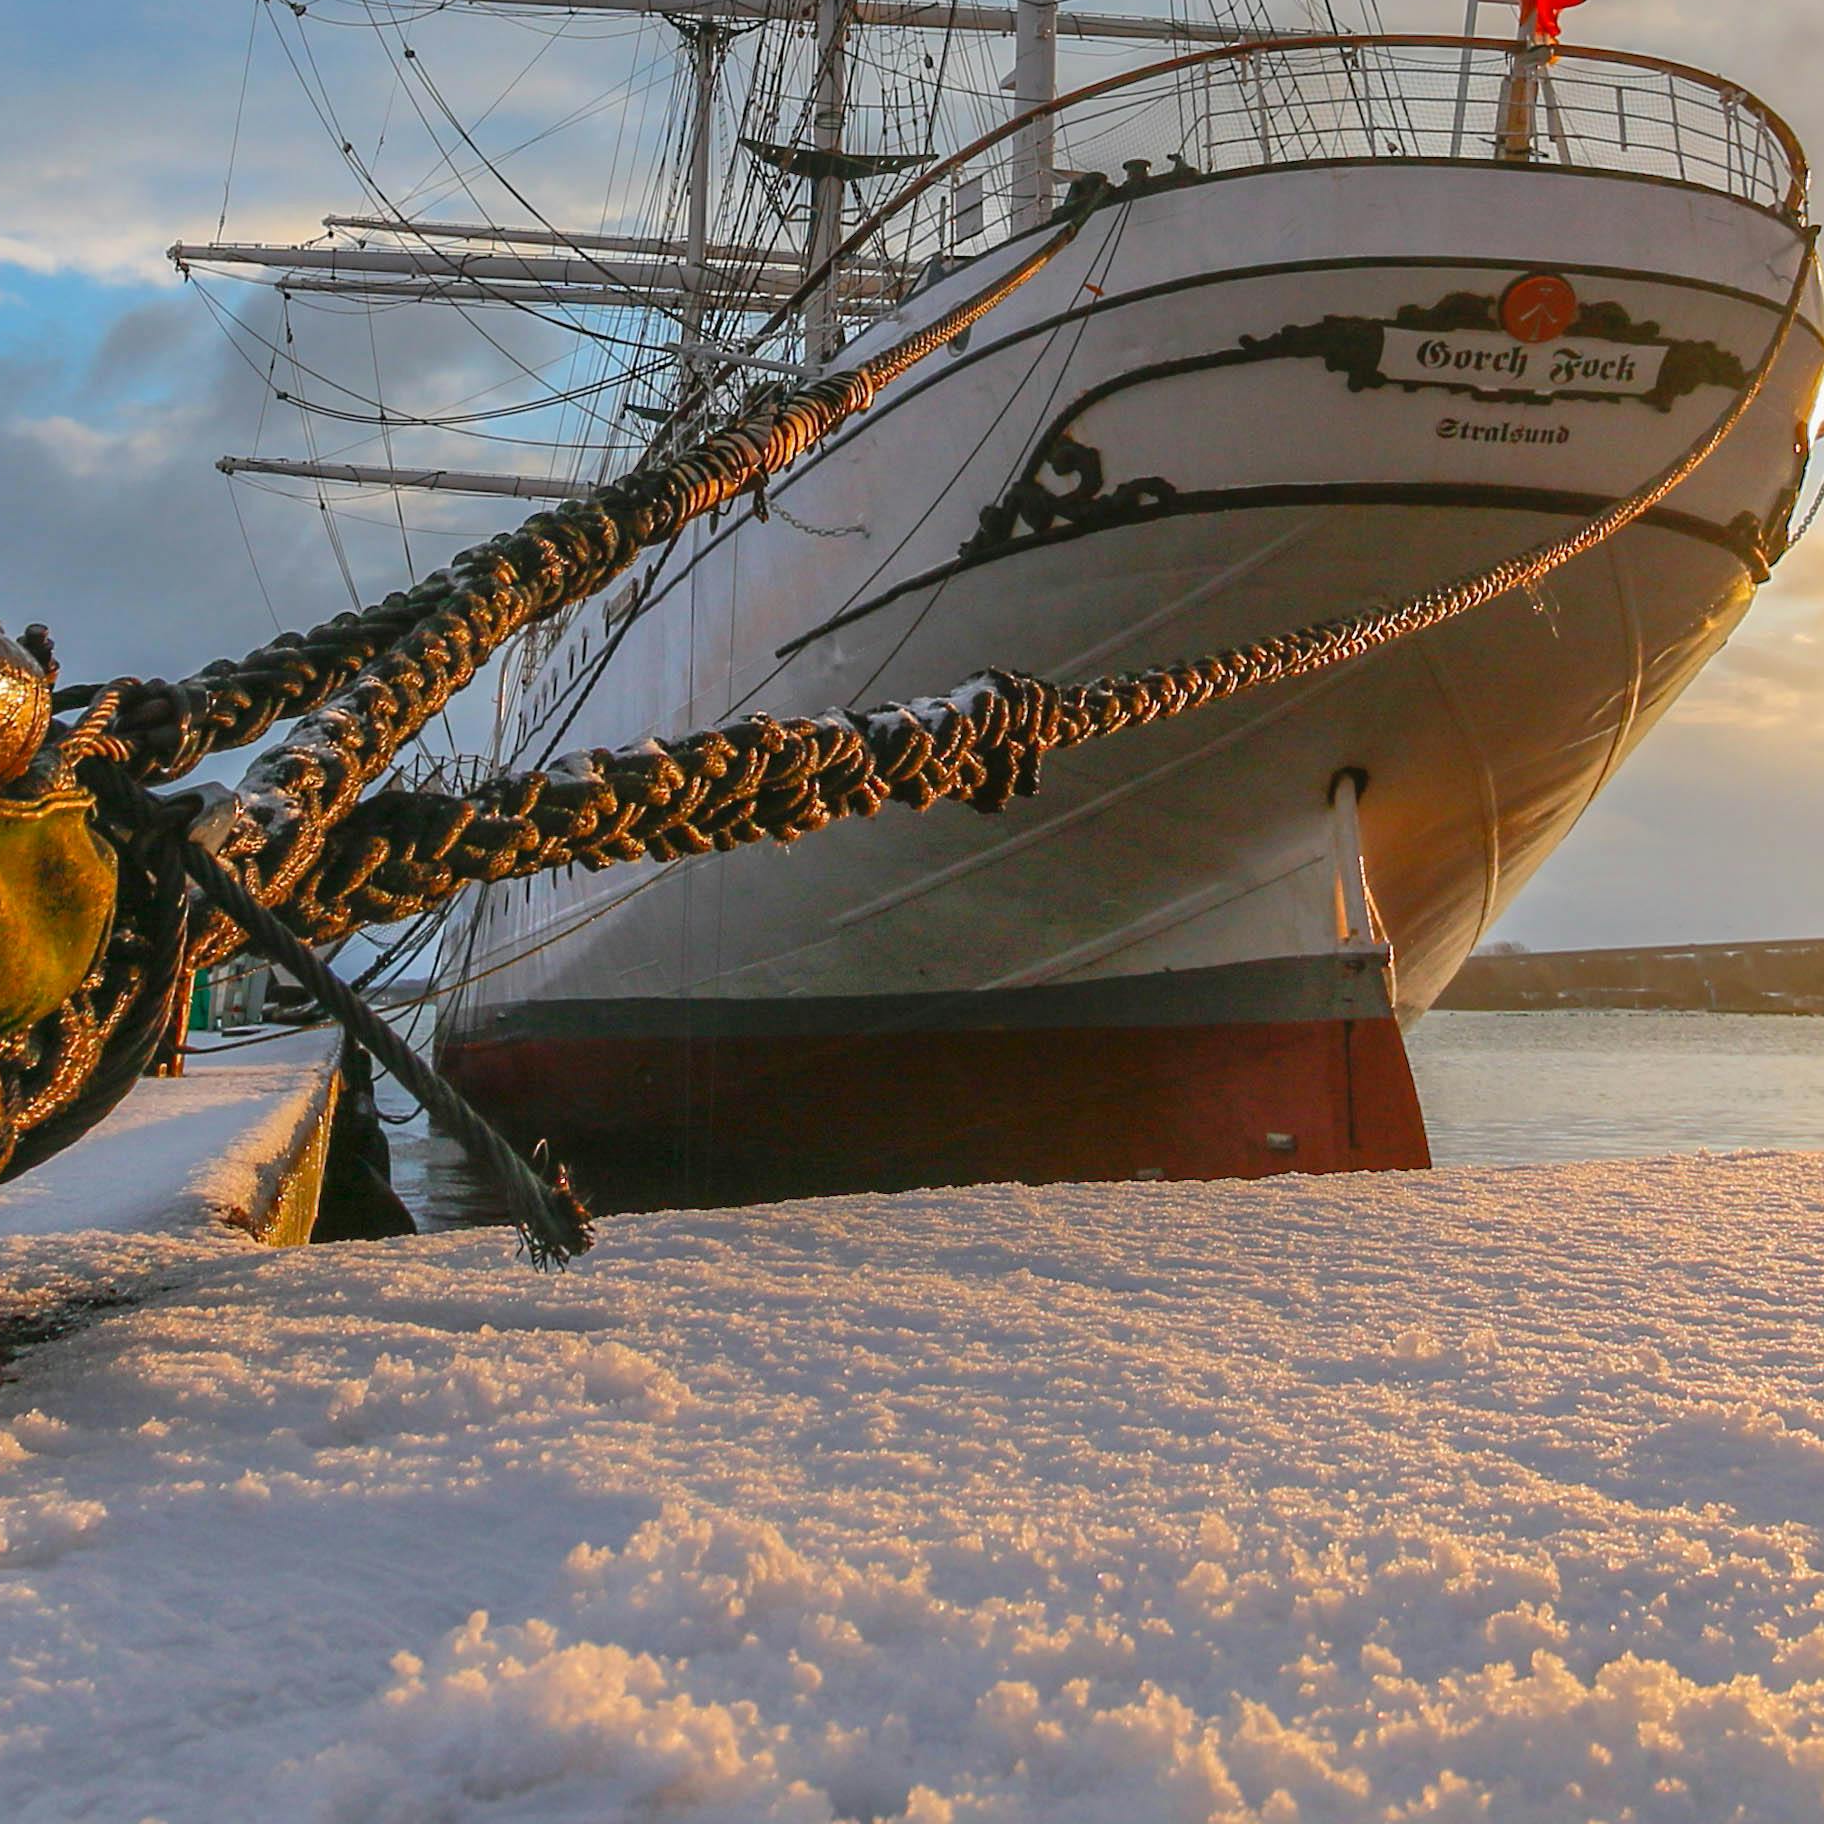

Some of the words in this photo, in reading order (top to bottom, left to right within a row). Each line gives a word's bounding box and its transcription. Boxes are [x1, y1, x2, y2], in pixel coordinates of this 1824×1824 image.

[1416, 339, 1528, 380] Gorch
[1549, 347, 1636, 385] Fock
[1436, 418, 1570, 445] Stralsund
